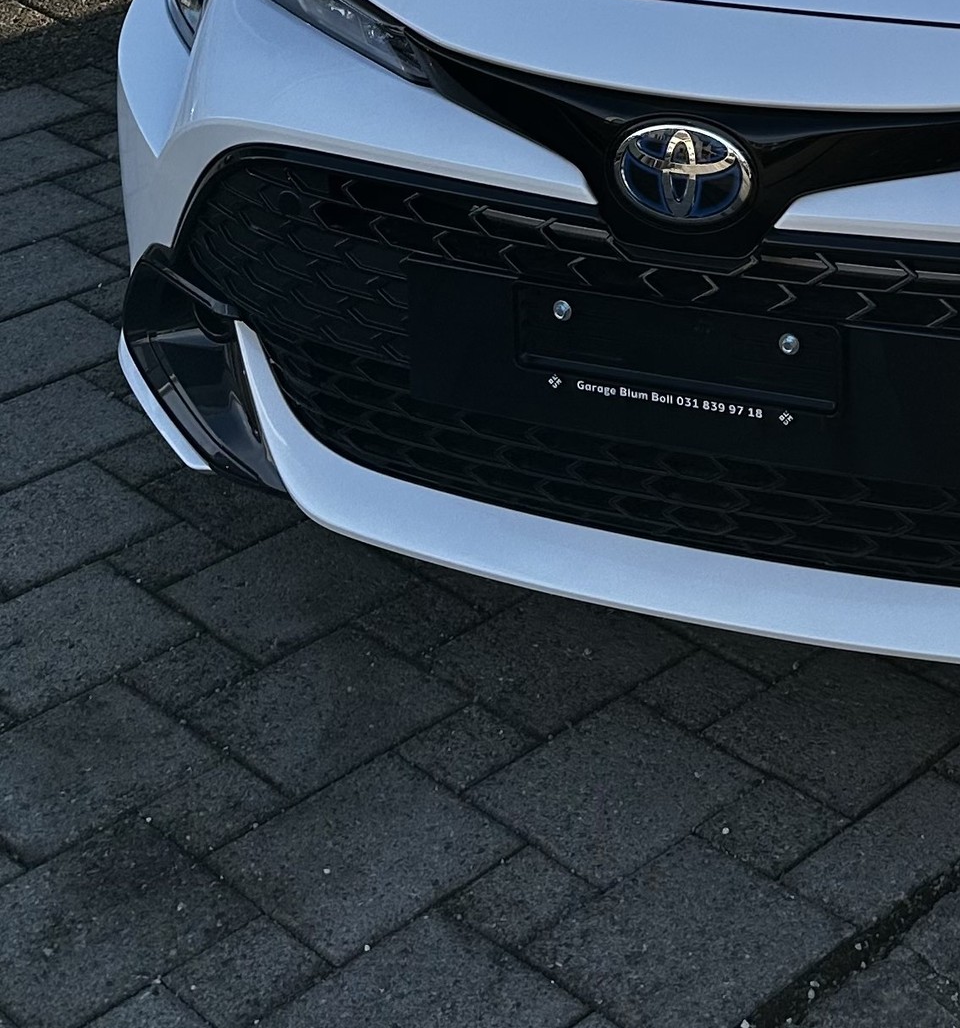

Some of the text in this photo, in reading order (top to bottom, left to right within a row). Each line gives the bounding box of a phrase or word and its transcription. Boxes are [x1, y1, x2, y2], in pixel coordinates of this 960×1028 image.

[576, 380, 763, 419] Garage Blum Boll 031 839 97 18
